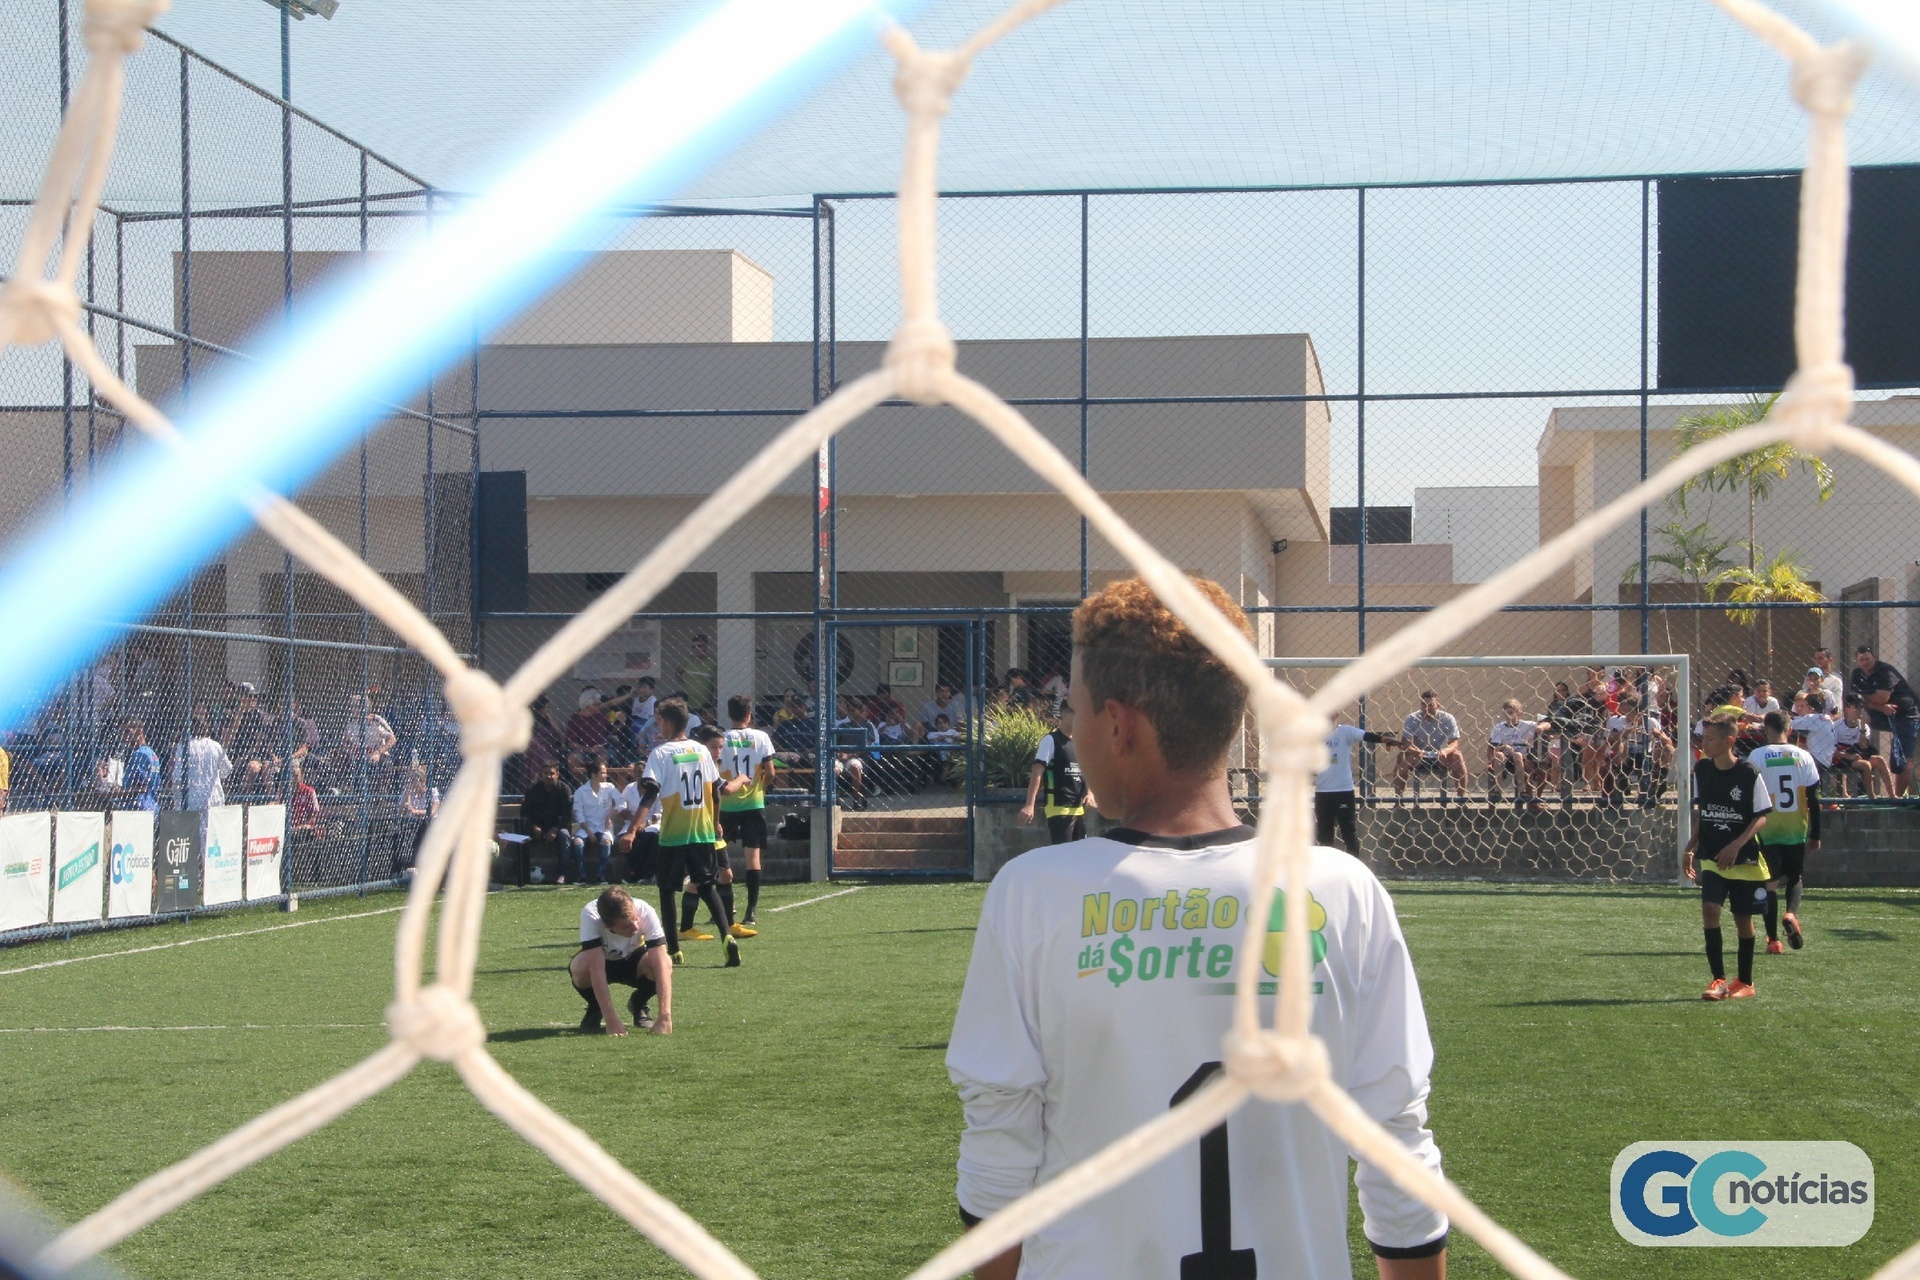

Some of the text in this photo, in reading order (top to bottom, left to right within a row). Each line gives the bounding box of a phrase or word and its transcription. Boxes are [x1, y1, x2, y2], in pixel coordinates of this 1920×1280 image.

[733, 755, 752, 780] 11
[1765, 751, 1799, 759] aurora
[681, 770, 702, 806] 10
[1779, 775, 1794, 808] 5
[1701, 809, 1743, 820] FLAMENGO
[1707, 803, 1736, 813] ESCOLA
[1081, 887, 1240, 938] Nortão
[1077, 941, 1106, 970] dá
[1168, 1061, 1257, 1280] 1
